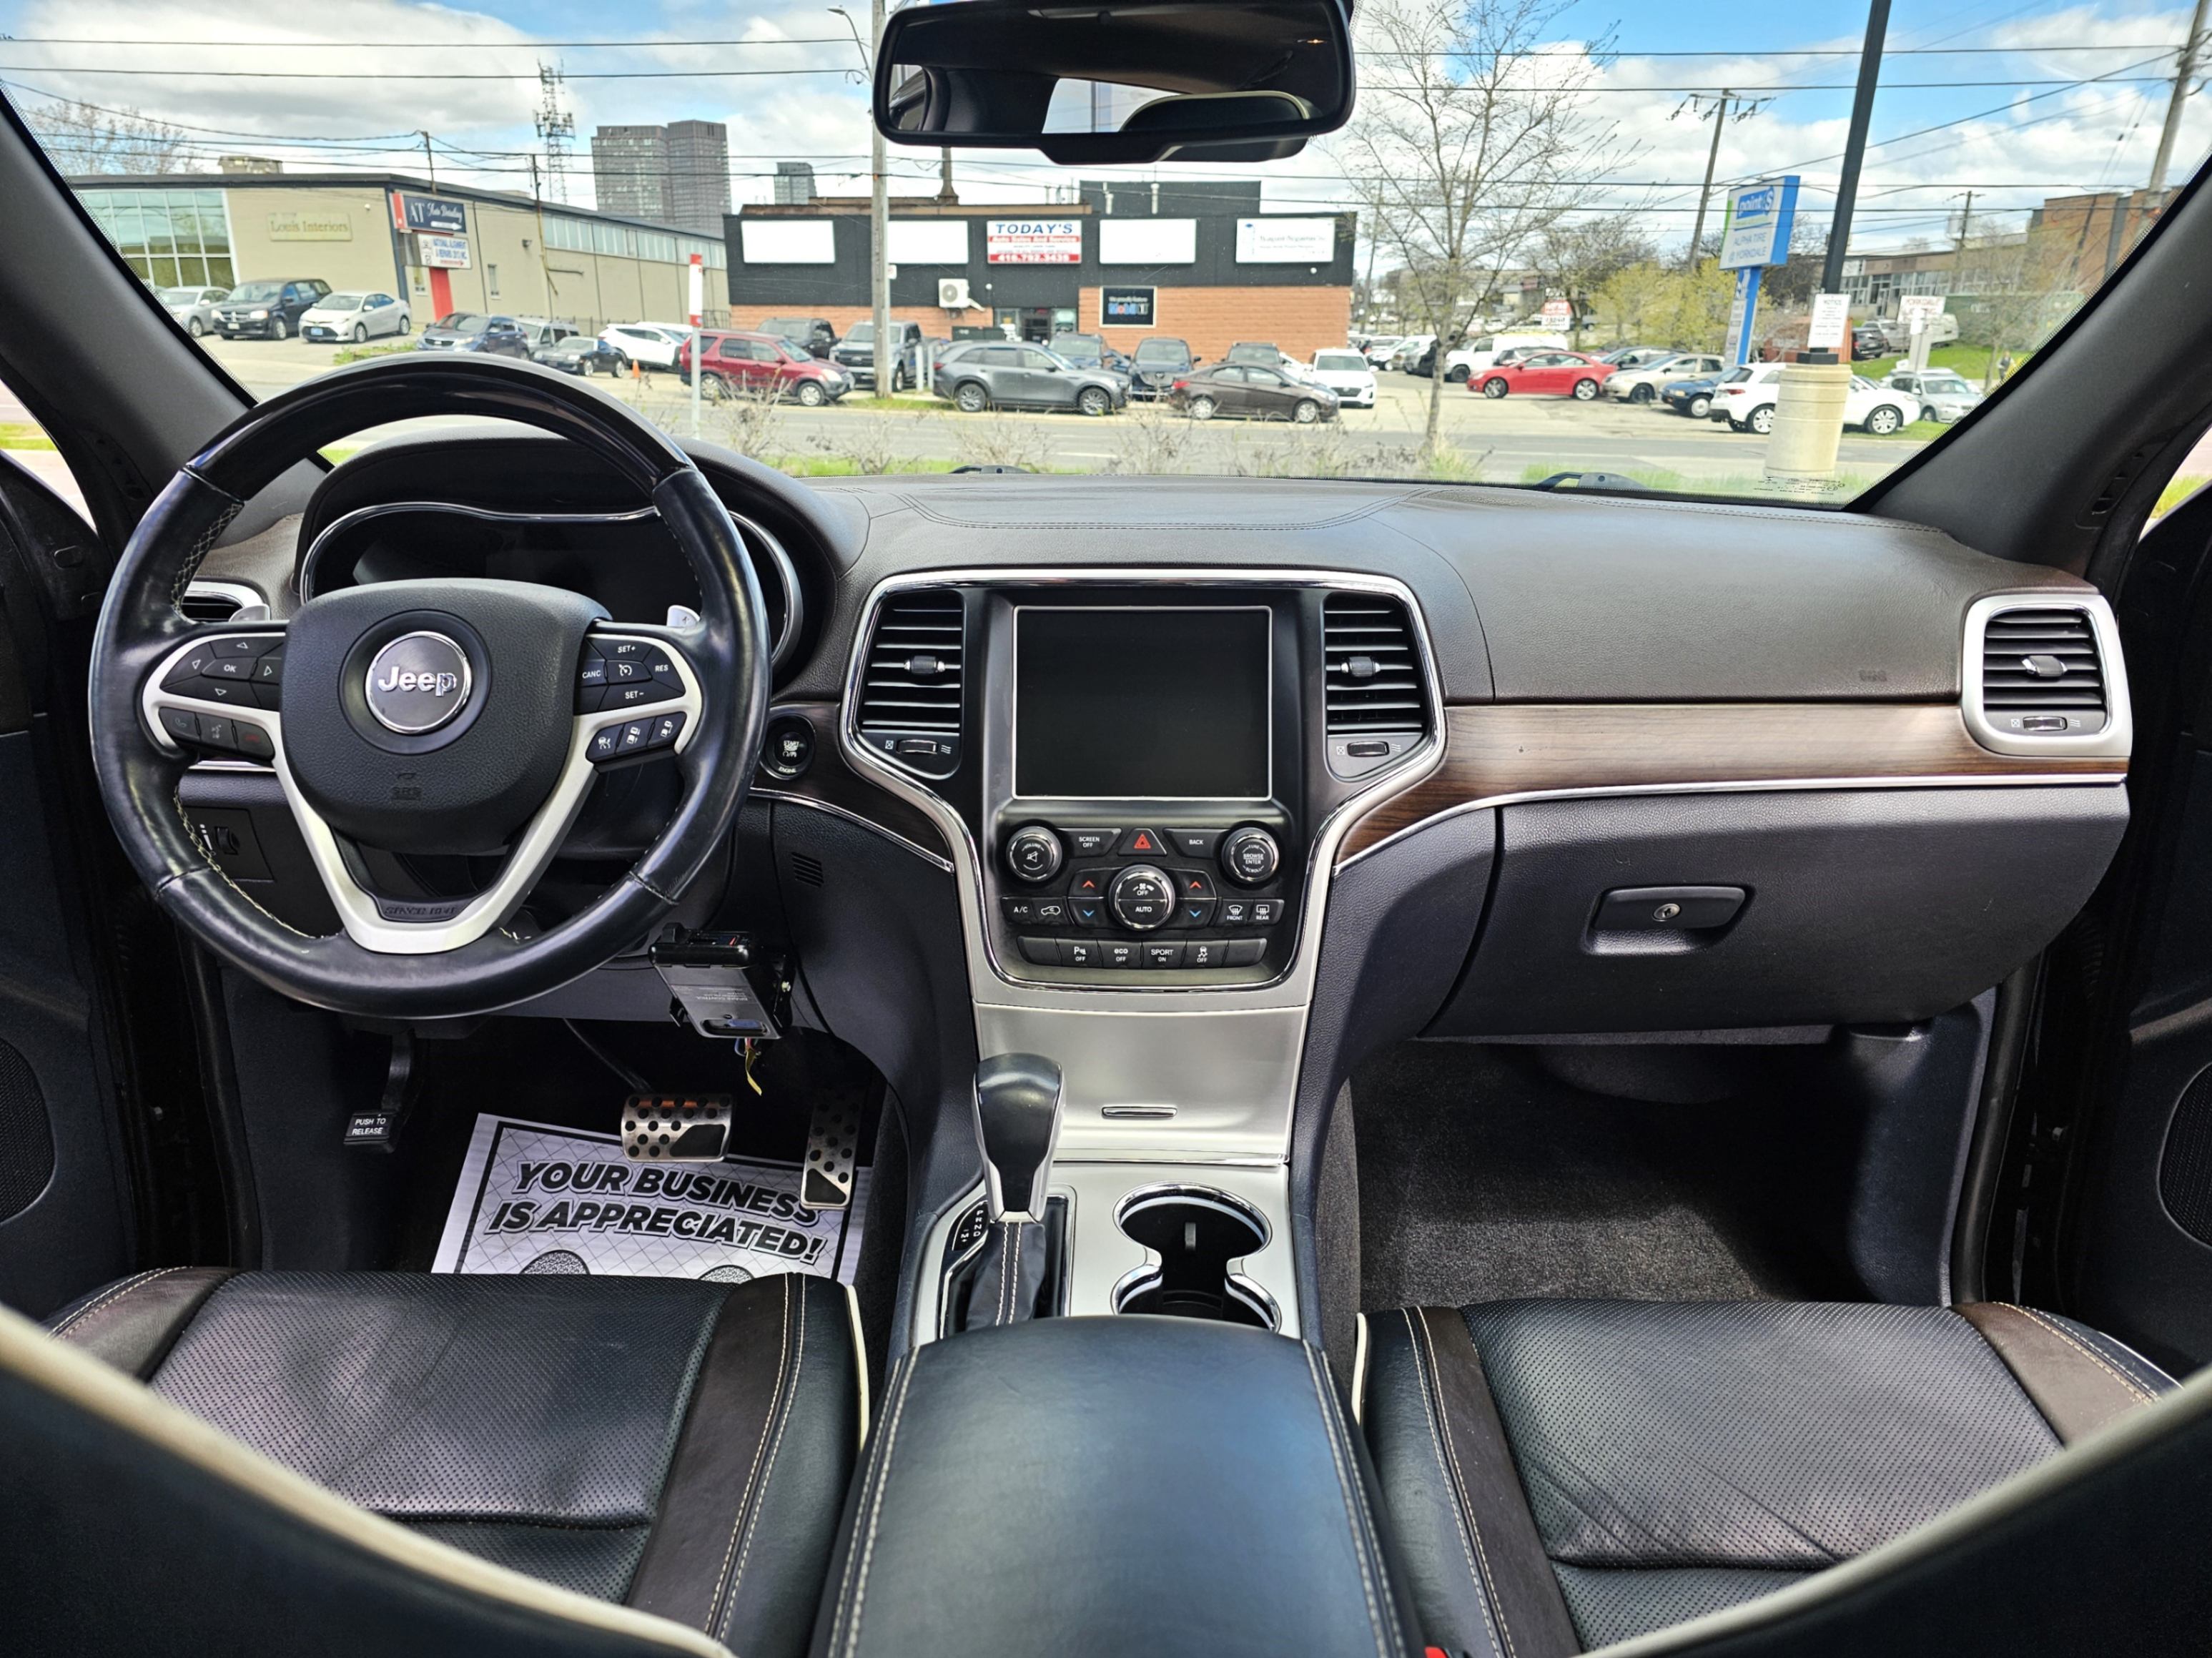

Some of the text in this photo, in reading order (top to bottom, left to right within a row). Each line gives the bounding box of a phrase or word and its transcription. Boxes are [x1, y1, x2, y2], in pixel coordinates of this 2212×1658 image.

[410, 202, 425, 223] AT
[270, 219, 349, 232] Louis Interiors
[996, 223, 1073, 235] TODAY'S
[223, 664, 237, 673] OK
[582, 670, 602, 679] CANC
[655, 664, 669, 673] RES
[377, 666, 458, 697] Jeep
[351, 1127, 384, 1136] RELEASE
[515, 1160, 819, 1225] YOUR BUSINESS
[488, 1200, 827, 1263] IS APPRECIATED!
